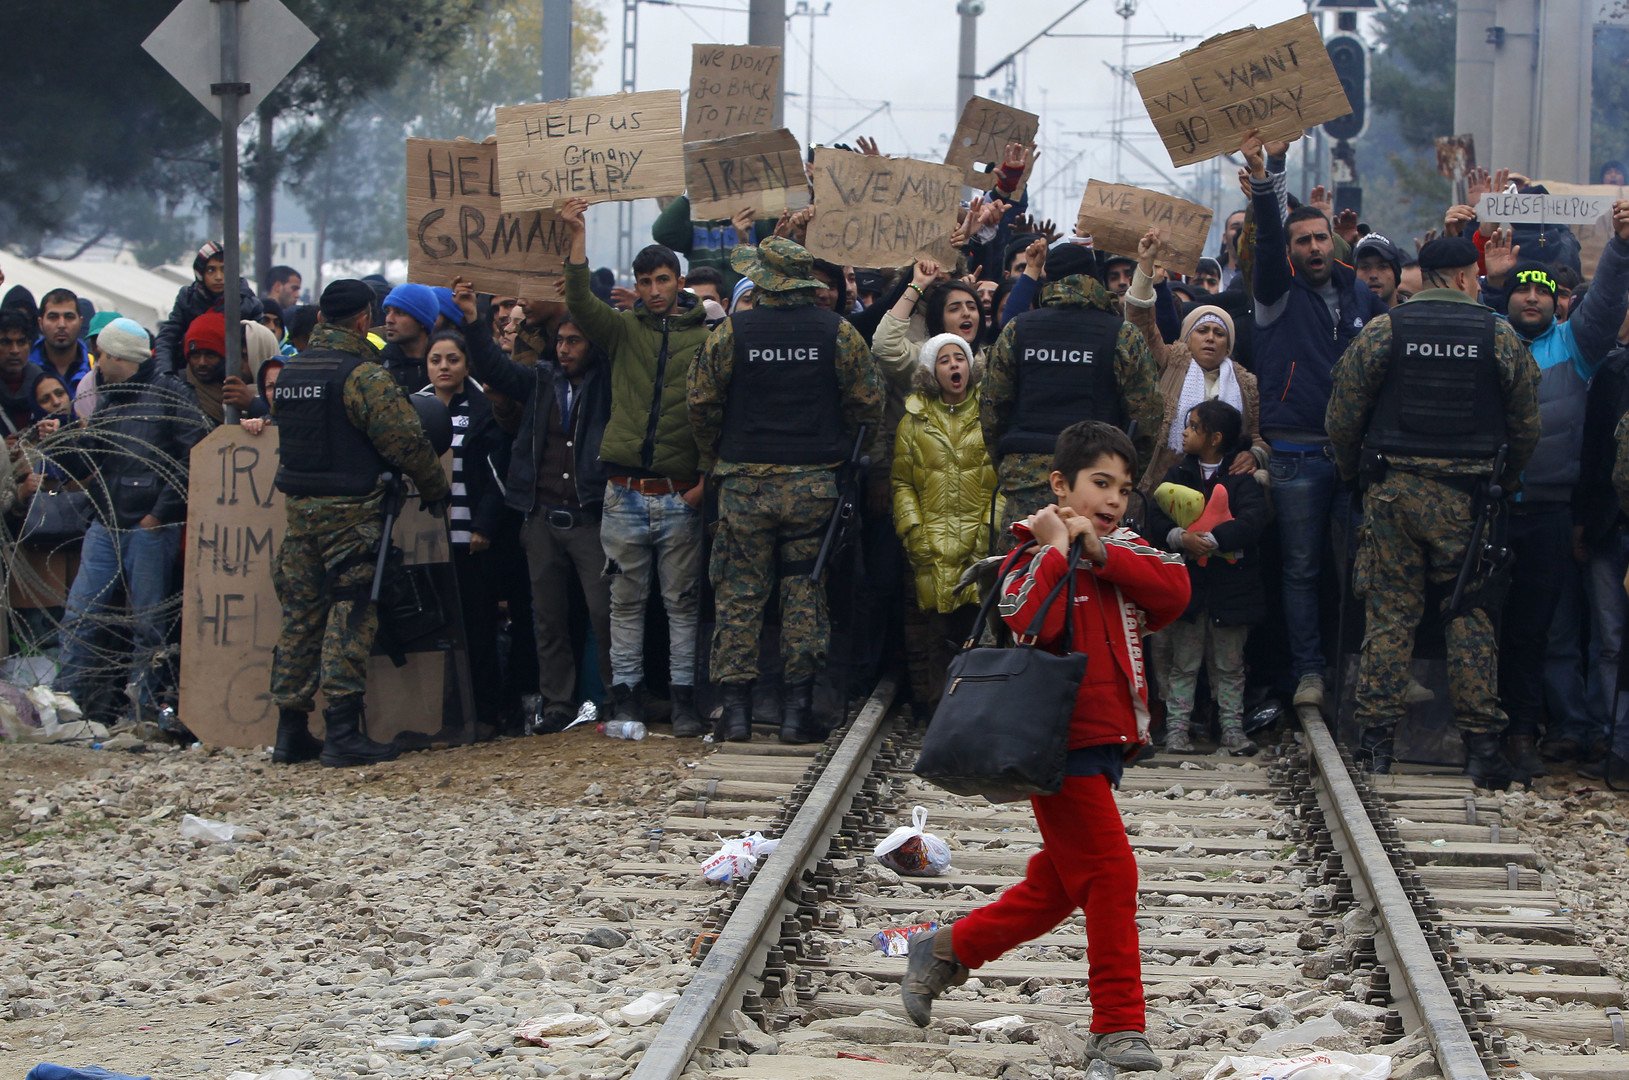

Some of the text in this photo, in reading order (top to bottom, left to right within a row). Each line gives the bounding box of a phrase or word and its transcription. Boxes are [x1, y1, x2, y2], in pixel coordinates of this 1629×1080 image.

[731, 53, 778, 76] DONT
[1153, 40, 1299, 112] WE WANT
[726, 77, 770, 101] BACK
[697, 105, 768, 126] TO THE
[1219, 87, 1303, 130] TODAY
[524, 113, 601, 147] HELP
[698, 151, 789, 201] IRAN
[826, 164, 960, 214] WE MUST
[1098, 188, 1213, 233] WE WANT
[1486, 196, 1543, 217] PLEASE
[1516, 270, 1556, 294] YOLO
[748, 347, 819, 362] POLICE
[1024, 348, 1094, 364] POLICE
[1406, 343, 1478, 358] POLICE
[275, 386, 322, 399] POLICE
